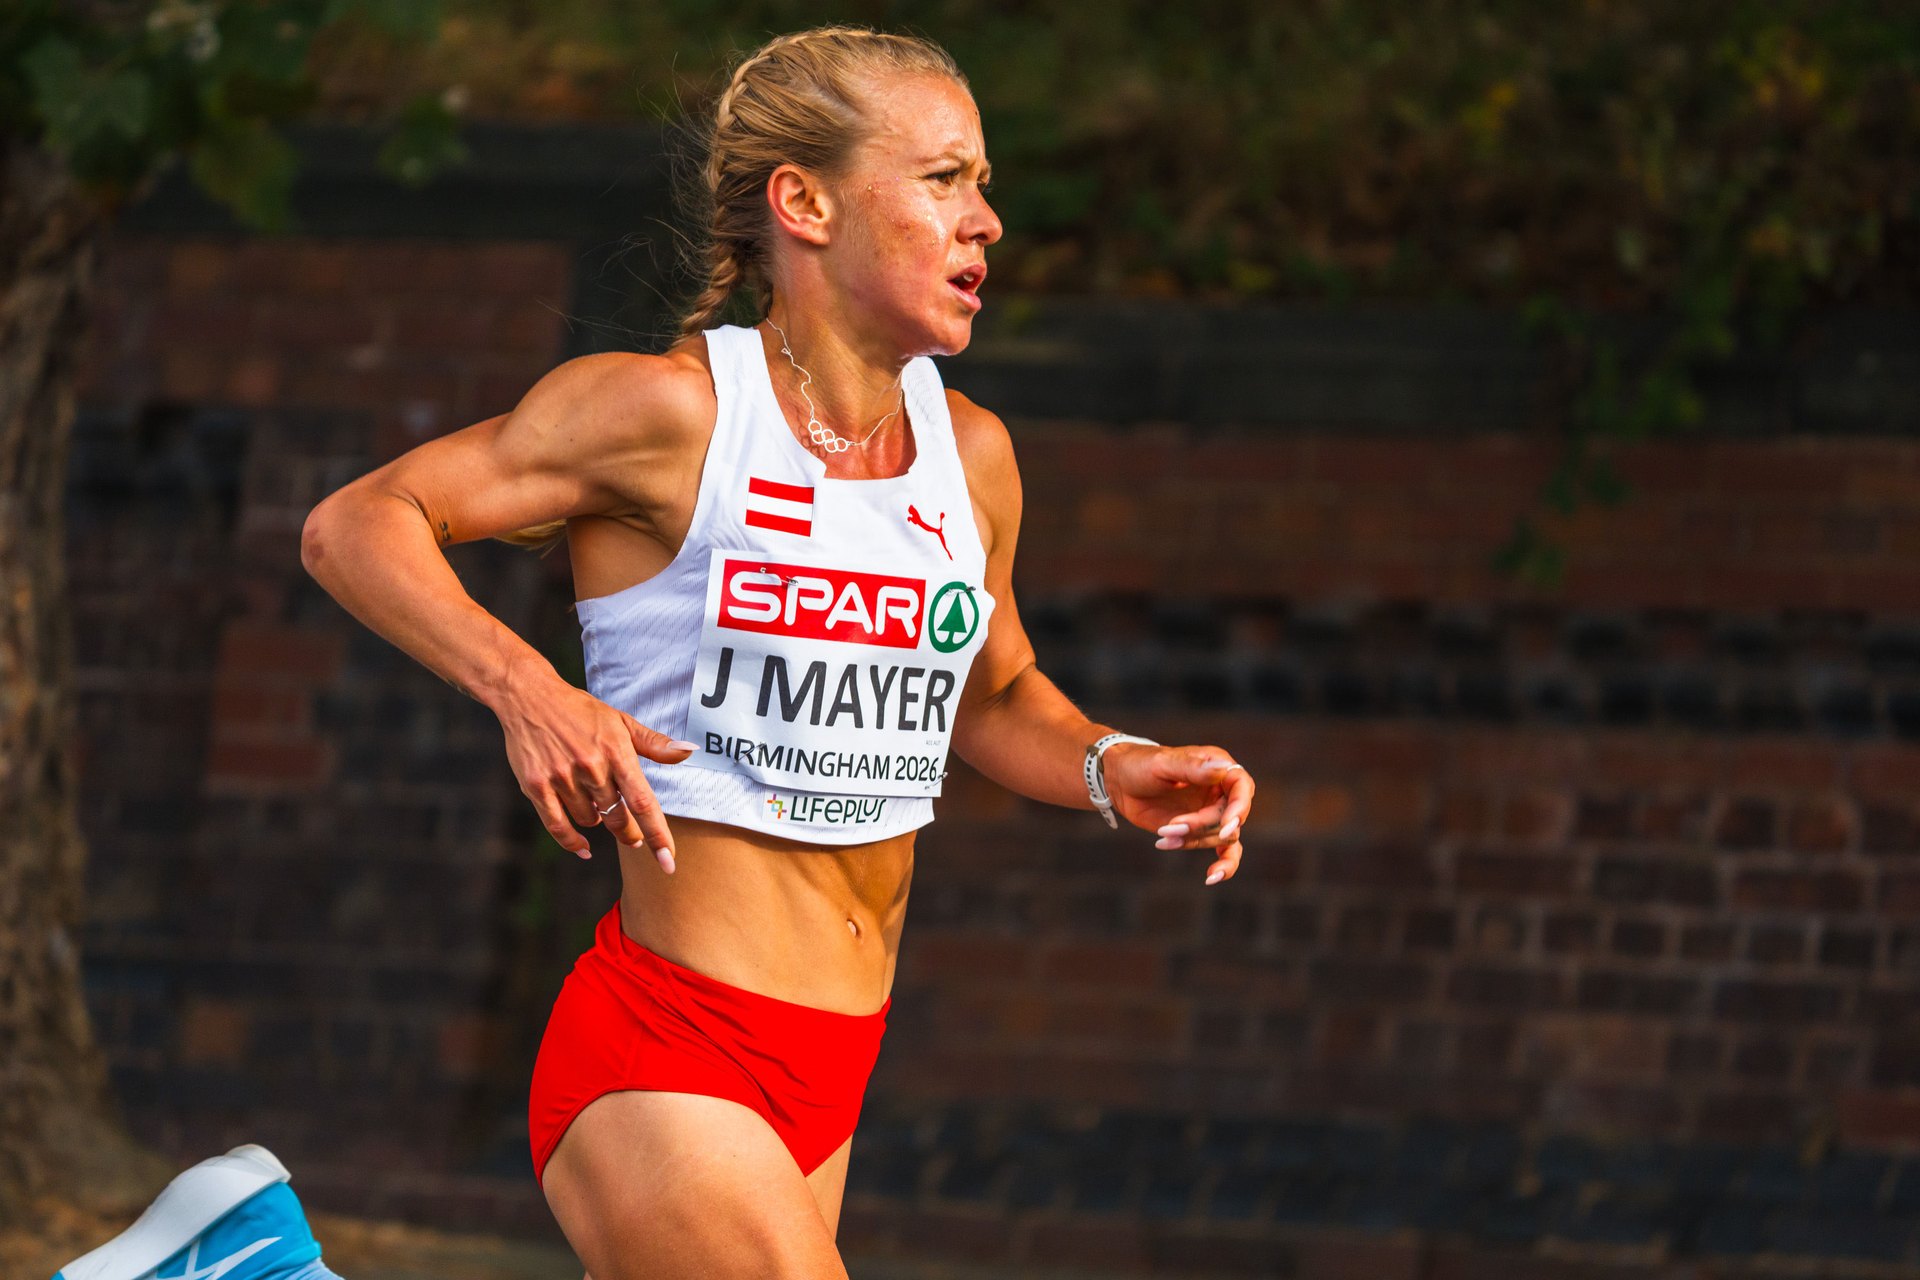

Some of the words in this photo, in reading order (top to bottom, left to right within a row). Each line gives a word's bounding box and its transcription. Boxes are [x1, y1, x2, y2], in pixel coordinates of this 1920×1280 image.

[727, 570, 920, 639] SPAR
[700, 647, 734, 709] J
[756, 655, 955, 732] MAYER
[705, 731, 890, 780] BIRMINGHAM
[895, 755, 939, 782] 2026
